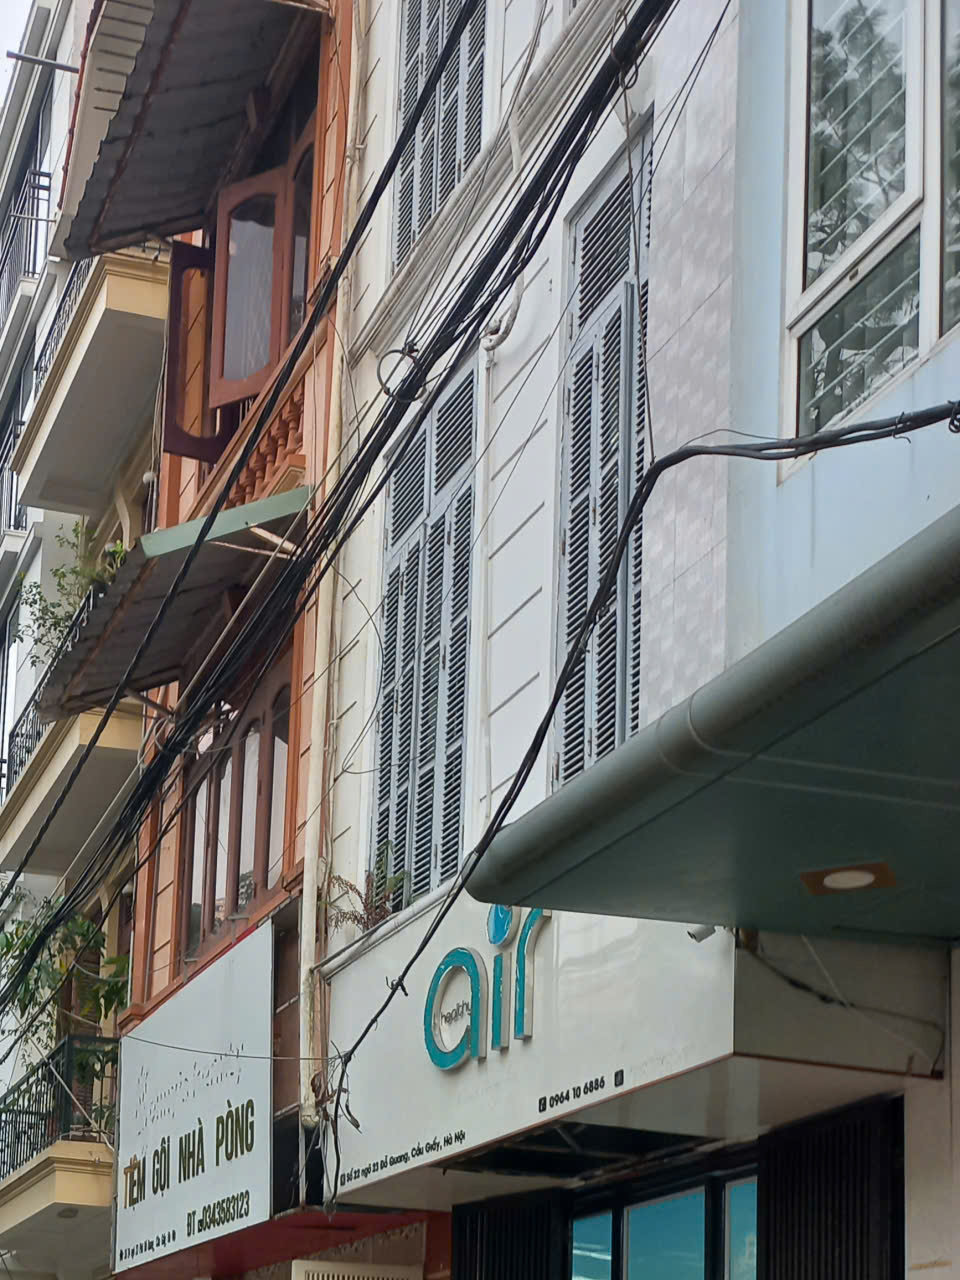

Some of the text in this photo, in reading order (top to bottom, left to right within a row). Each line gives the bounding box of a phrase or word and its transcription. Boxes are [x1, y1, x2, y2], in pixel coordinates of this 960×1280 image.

[440, 1000, 472, 1026] healthy
[549, 1076, 605, 1108] 0964 10 6886
[178, 1117, 205, 1184] NHÀ
[216, 1099, 254, 1166] PÒNG
[443, 1133, 453, 1147] Hà
